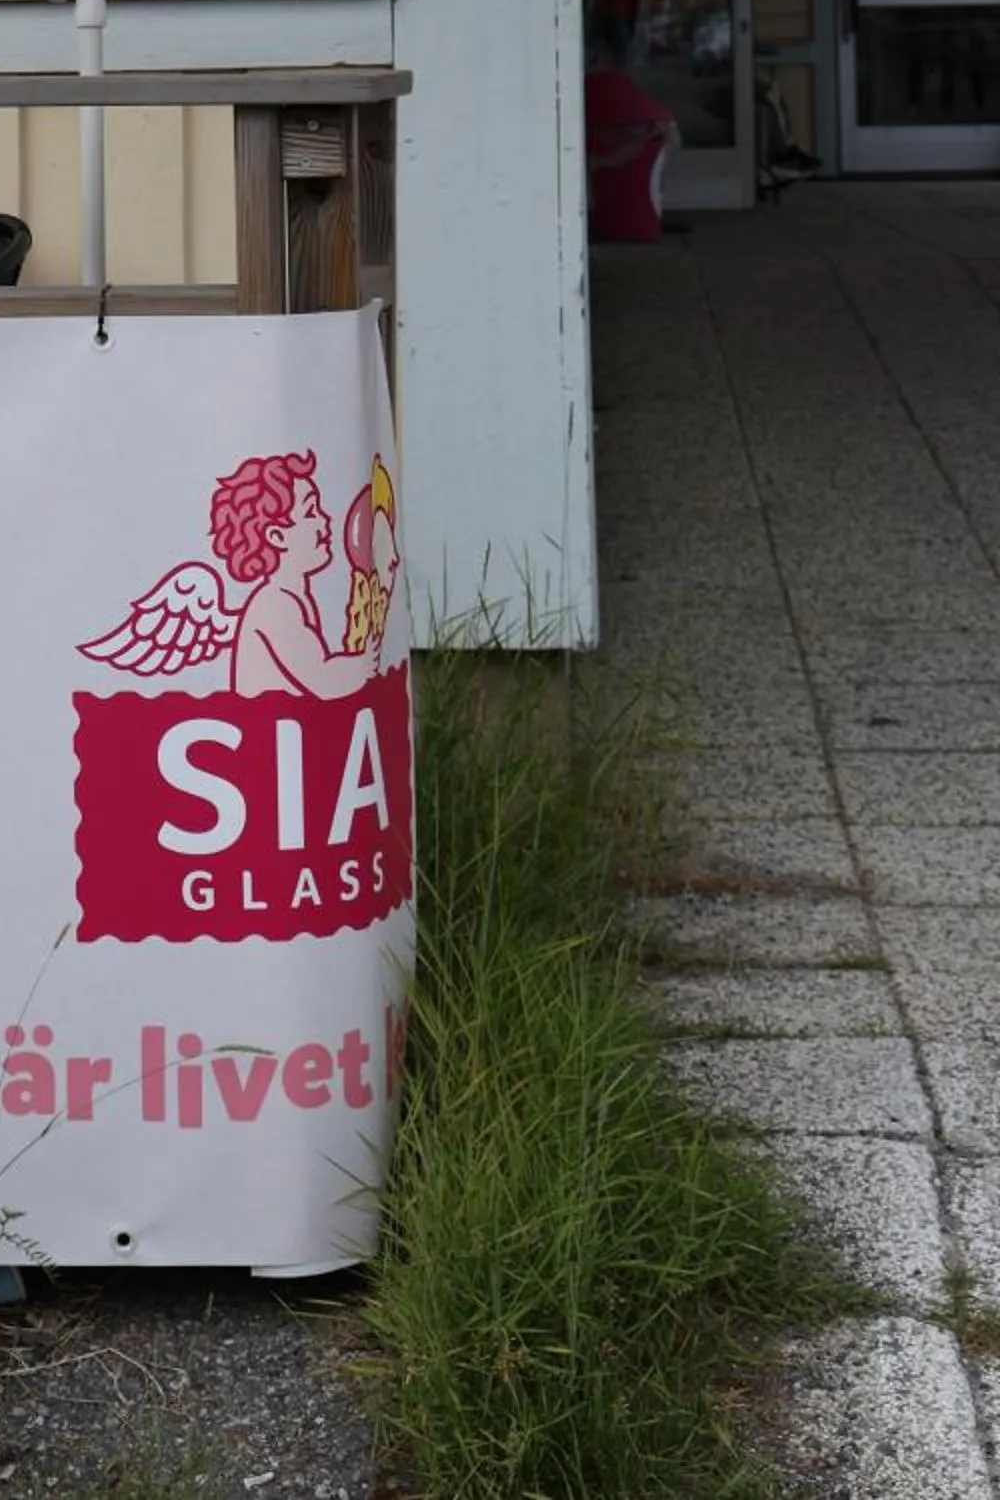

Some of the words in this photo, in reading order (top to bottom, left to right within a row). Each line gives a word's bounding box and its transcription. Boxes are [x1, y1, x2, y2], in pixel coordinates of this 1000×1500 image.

[157, 707, 390, 856] SIA
[181, 852, 384, 911] GLASS
[140, 1025, 375, 1129] livet
